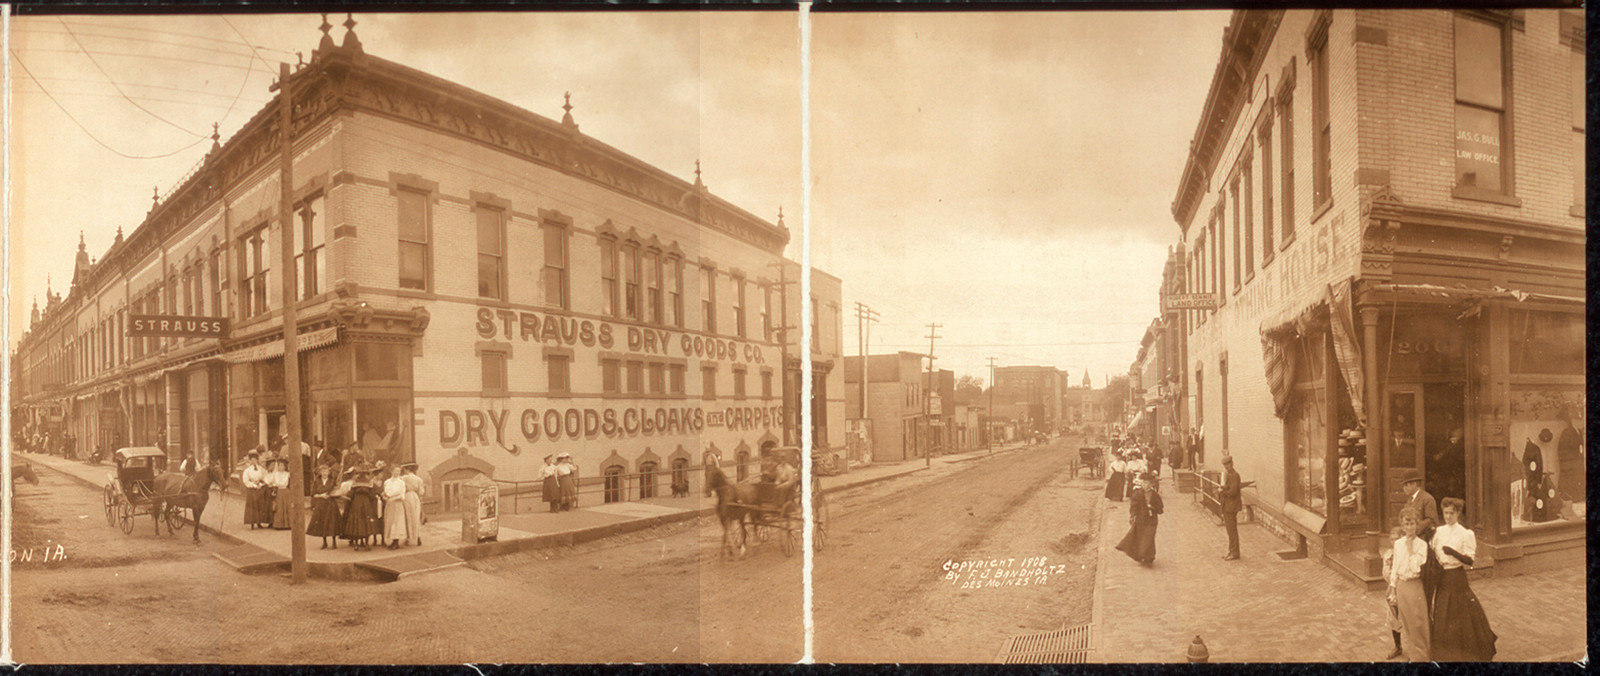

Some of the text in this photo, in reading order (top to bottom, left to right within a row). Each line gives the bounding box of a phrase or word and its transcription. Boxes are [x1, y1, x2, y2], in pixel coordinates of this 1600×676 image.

[1457, 150, 1471, 159] LAW
[134, 319, 222, 333] STRAUSS
[476, 307, 765, 364] STRAUSS DRY GOODS CO.
[438, 408, 521, 456] DRY
[623, 407, 705, 436] CLOAKS
[725, 405, 783, 431] CARPETS
